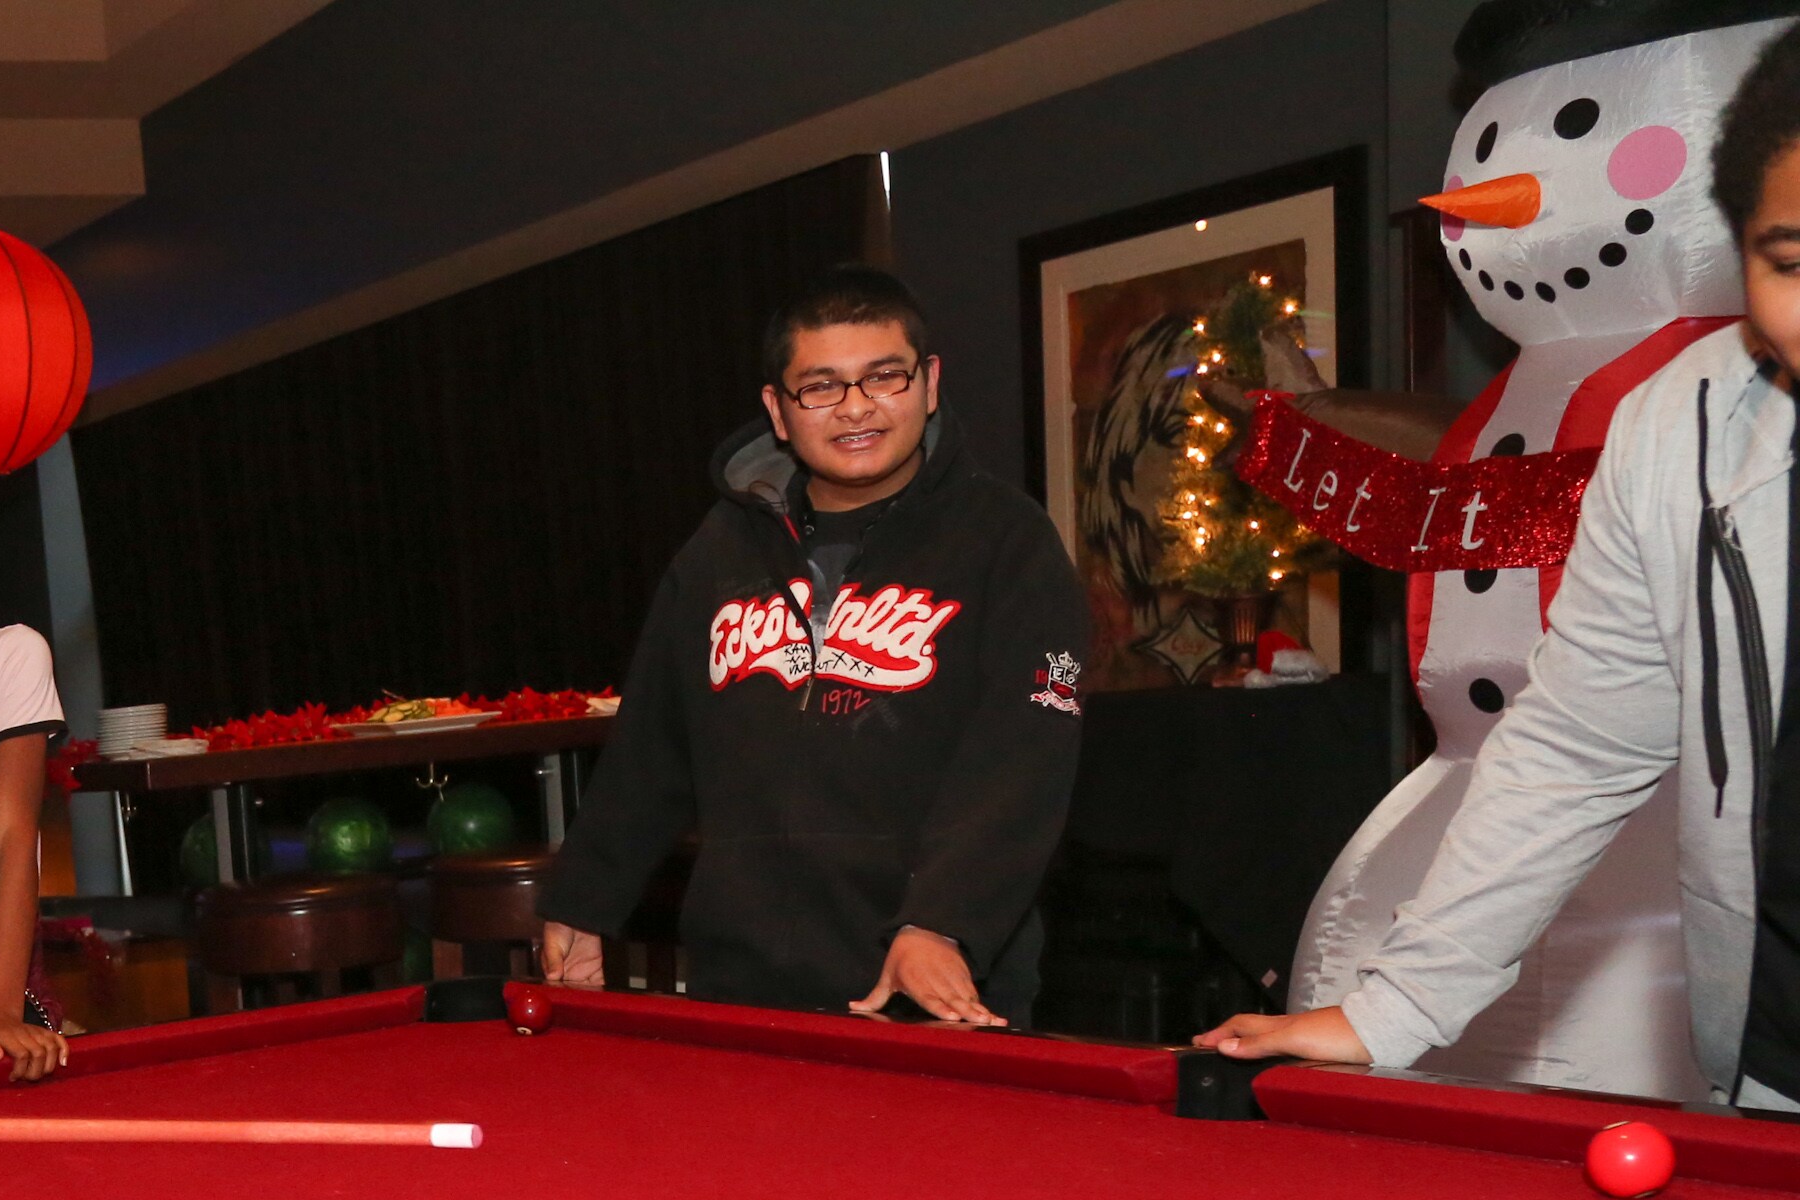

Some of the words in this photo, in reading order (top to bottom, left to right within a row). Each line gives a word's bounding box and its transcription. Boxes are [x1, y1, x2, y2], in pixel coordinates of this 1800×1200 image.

[1283, 427, 1372, 532] Let
[1411, 486, 1488, 552] It
[822, 688, 871, 715] 1972
